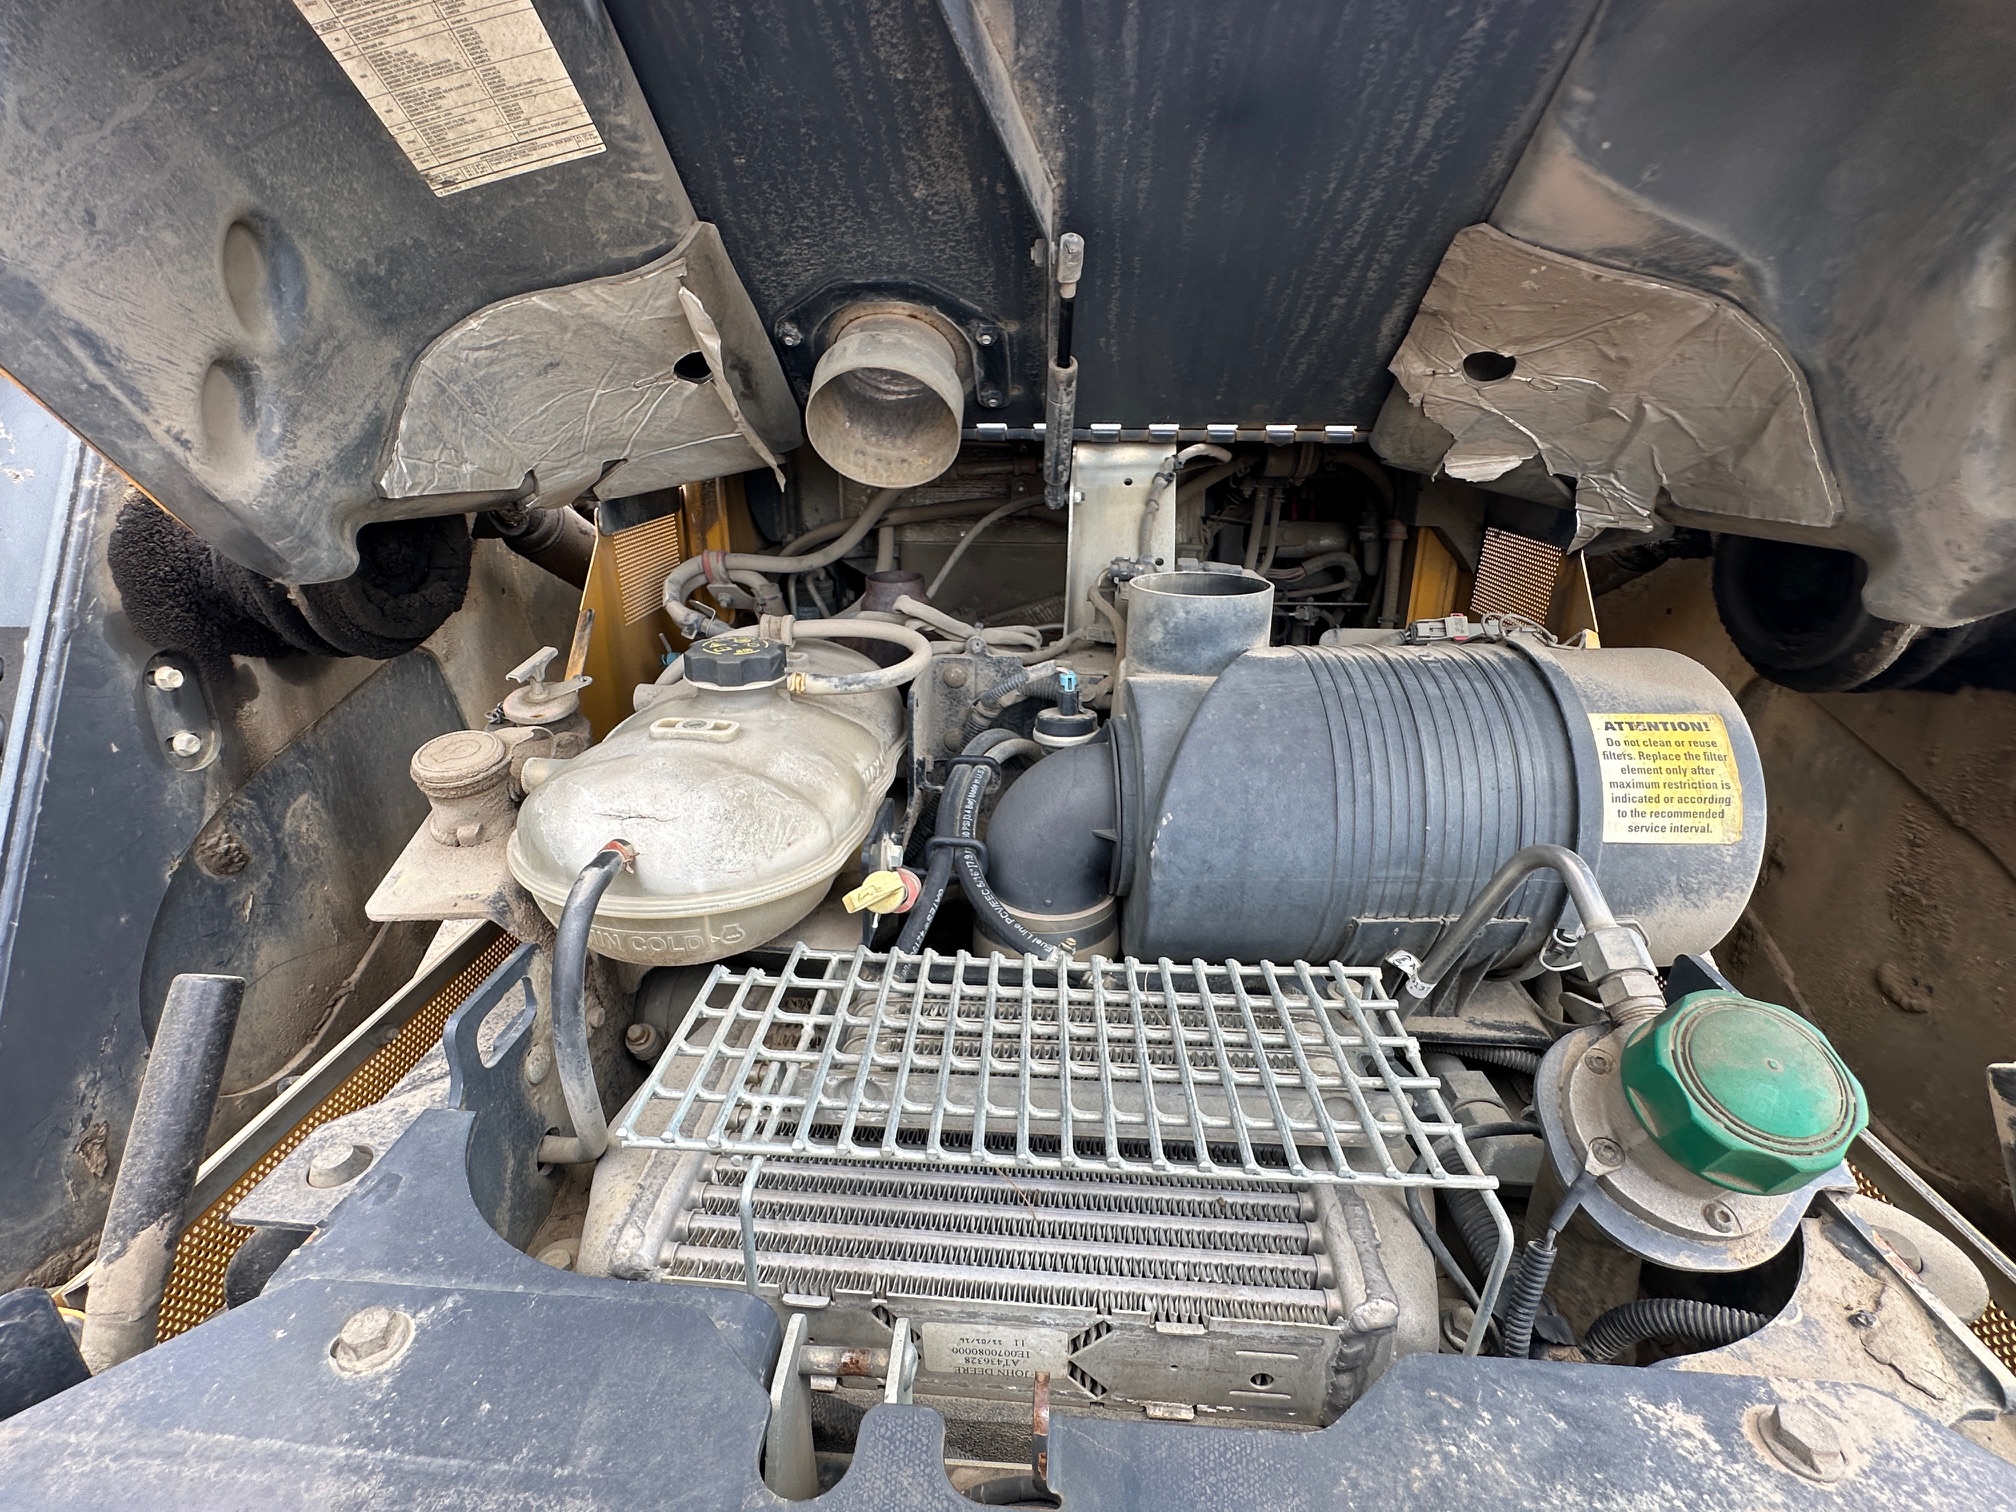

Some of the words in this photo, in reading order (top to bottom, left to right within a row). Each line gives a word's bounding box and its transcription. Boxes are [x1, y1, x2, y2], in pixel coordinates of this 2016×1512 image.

[1604, 721, 1711, 732] ATTENTION!
[1606, 738, 1621, 747] Do
[1624, 739, 1640, 747] not
[1643, 739, 1672, 747] clean
[1689, 740, 1717, 748] reuse
[1603, 751, 1635, 760] filters.
[1638, 751, 1681, 763] Replace
[1684, 752, 1701, 761] the
[1703, 752, 1727, 762] filter
[1621, 765, 1663, 775] element
[1666, 766, 1687, 777] only
[1691, 766, 1715, 775] after
[1609, 779, 1660, 789] maximum
[1663, 780, 1718, 790] restriction
[1721, 781, 1731, 790] is
[968, 785, 979, 798] Made
[1611, 793, 1660, 804] indicated
[1664, 796, 1673, 804] or
[1677, 794, 1731, 806] according
[1617, 809, 1627, 818] to
[1630, 809, 1646, 818] the
[1650, 809, 1725, 818] recommended
[962, 821, 970, 830] PSI
[1628, 823, 1666, 833] service
[1670, 823, 1713, 833] interval.
[981, 888, 1015, 925] PCV/EEC
[1014, 923, 1033, 940] Line
[631, 935, 703, 951] COLD
[965, 1357, 1020, 1366] AT436328
[954, 1366, 996, 1374] DEERE
[998, 1369, 1031, 1377] JOHN
